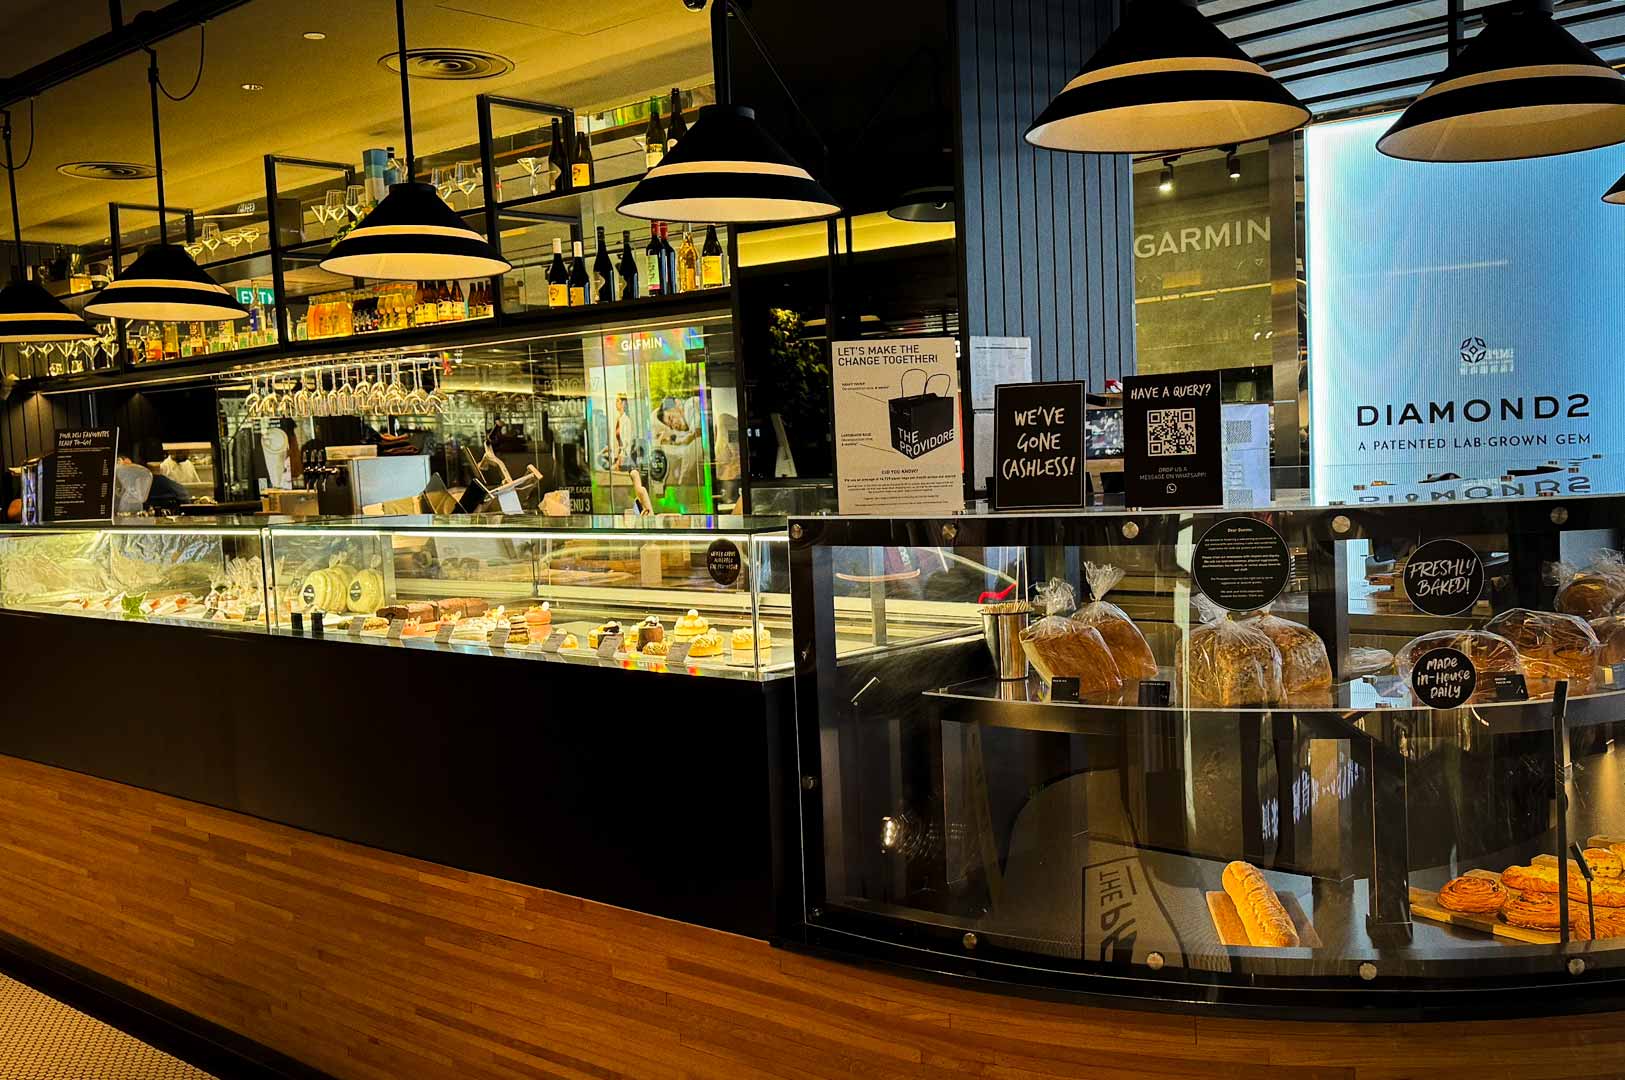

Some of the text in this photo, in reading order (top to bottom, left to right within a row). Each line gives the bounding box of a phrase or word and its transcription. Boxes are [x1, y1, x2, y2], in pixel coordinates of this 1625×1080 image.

[1134, 217, 1271, 258] GARMIN
[241, 291, 266, 304] EXT
[838, 344, 919, 356] LET'S MAKE THE
[838, 354, 938, 366] CHANGE TOGETHER!
[1130, 383, 1212, 400] HAVE A QUERY?
[1014, 406, 1065, 427] WE'VE
[1357, 393, 1590, 427] DIAMOND2
[898, 427, 920, 444] THE
[899, 428, 955, 457] PROVIDORE
[1017, 432, 1061, 453] GONE
[1358, 433, 1591, 451] A PATENTED LAB-GROWN GEM
[1002, 456, 1076, 480] CASHLESS!
[569, 498, 591, 512] ENU 3
[1408, 557, 1477, 579] FRESHLY
[1416, 577, 1470, 597] BAKED!
